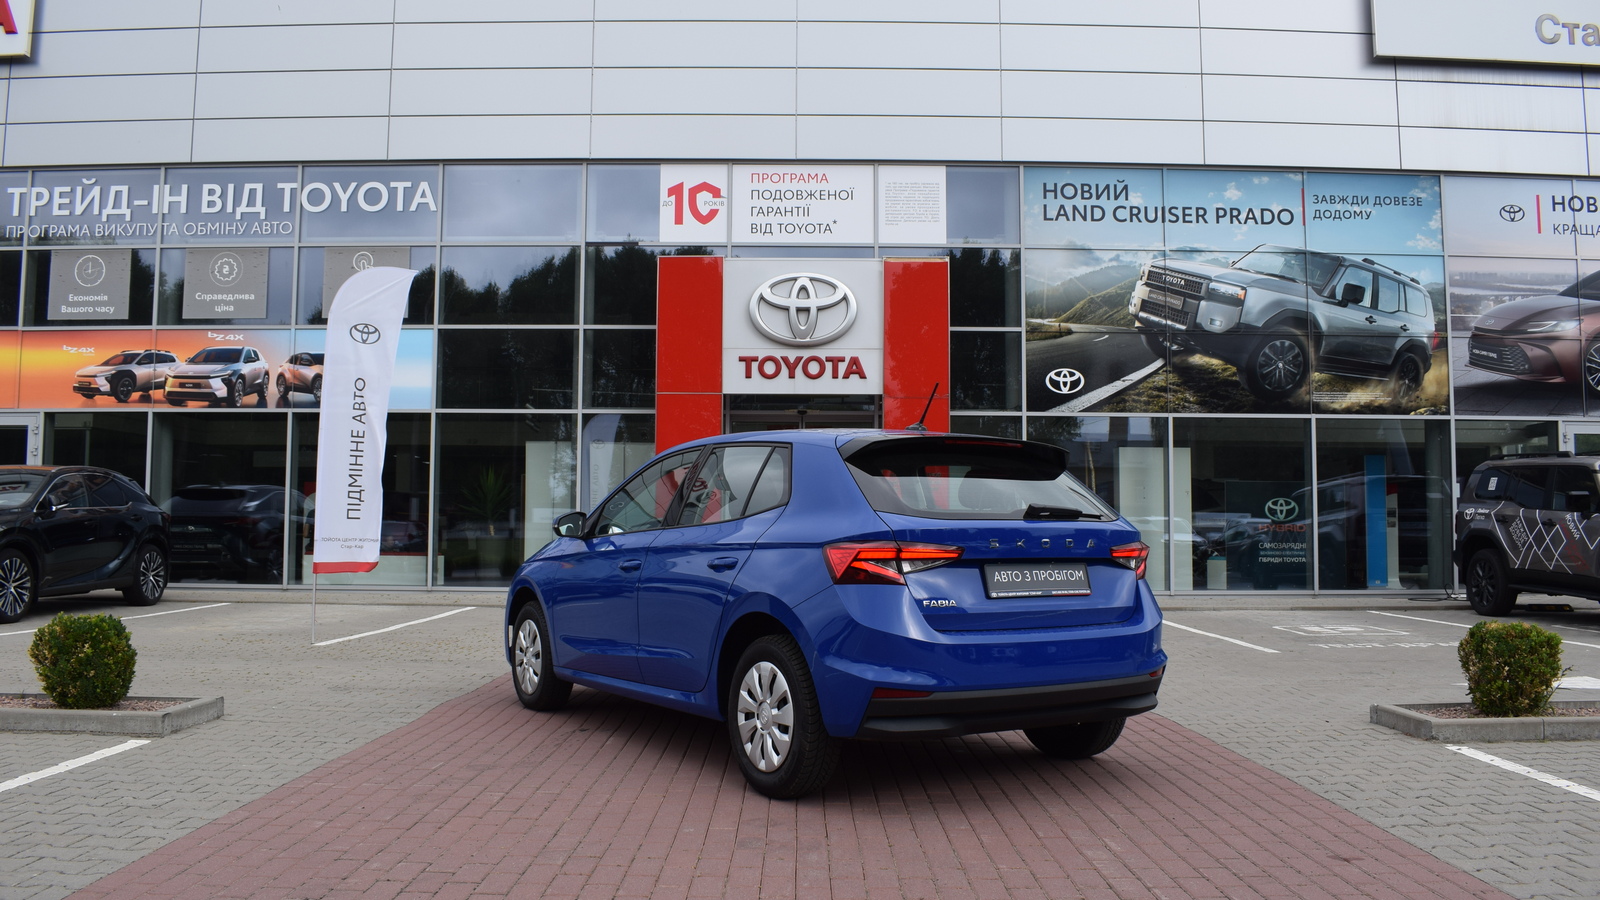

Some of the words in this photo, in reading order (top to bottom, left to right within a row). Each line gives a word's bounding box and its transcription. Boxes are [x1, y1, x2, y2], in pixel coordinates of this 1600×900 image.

[750, 172, 829, 184] ПРОГРАМА
[750, 187, 855, 203] ПОДОВЖЕНОЇ
[1041, 179, 1130, 202] НОВИЙ
[6, 177, 189, 221] ТРЕЙД-ІН
[200, 183, 267, 220] ВІД
[277, 181, 438, 214] TOYOTA
[662, 200, 673, 208] ДО
[1312, 193, 1370, 207] ЗАВЖДИ
[1372, 195, 1423, 209] ДОВЕЗЕ
[1551, 195, 1598, 213] НОВ
[750, 204, 811, 217] ГАРАНТІЇ
[1042, 203, 1106, 223] LAND
[1111, 204, 1209, 225] CRUISER
[1215, 206, 1295, 227] PRADO
[1312, 208, 1373, 222] ДОДОМУ
[5, 224, 91, 239] ПРОГРАМА
[94, 222, 158, 238] ВИКУПУ
[161, 222, 179, 236] ТА
[183, 221, 247, 237] ОБМІНУ
[249, 220, 294, 236] АВТО
[750, 223, 774, 236] ВІД
[1162, 275, 1184, 285] TOYOTA
[68, 293, 108, 303] Економія
[195, 292, 255, 302] Справедлива
[61, 305, 93, 314] Вашого
[95, 306, 115, 314] часу
[214, 302, 235, 313] ціна
[738, 355, 868, 380] TOYOTA
[352, 377, 367, 425] АВТО
[346, 429, 366, 520] ПІДМІННЕ
[1258, 523, 1307, 532] HYBRID
[1258, 542, 1307, 550] САМОЗАРЯДНІ
[1258, 556, 1283, 564] ГІБРИДИ
[993, 569, 1023, 583] АВТО
[1033, 568, 1085, 582] ПРОБІГОМ
[922, 598, 958, 608] FABIA
